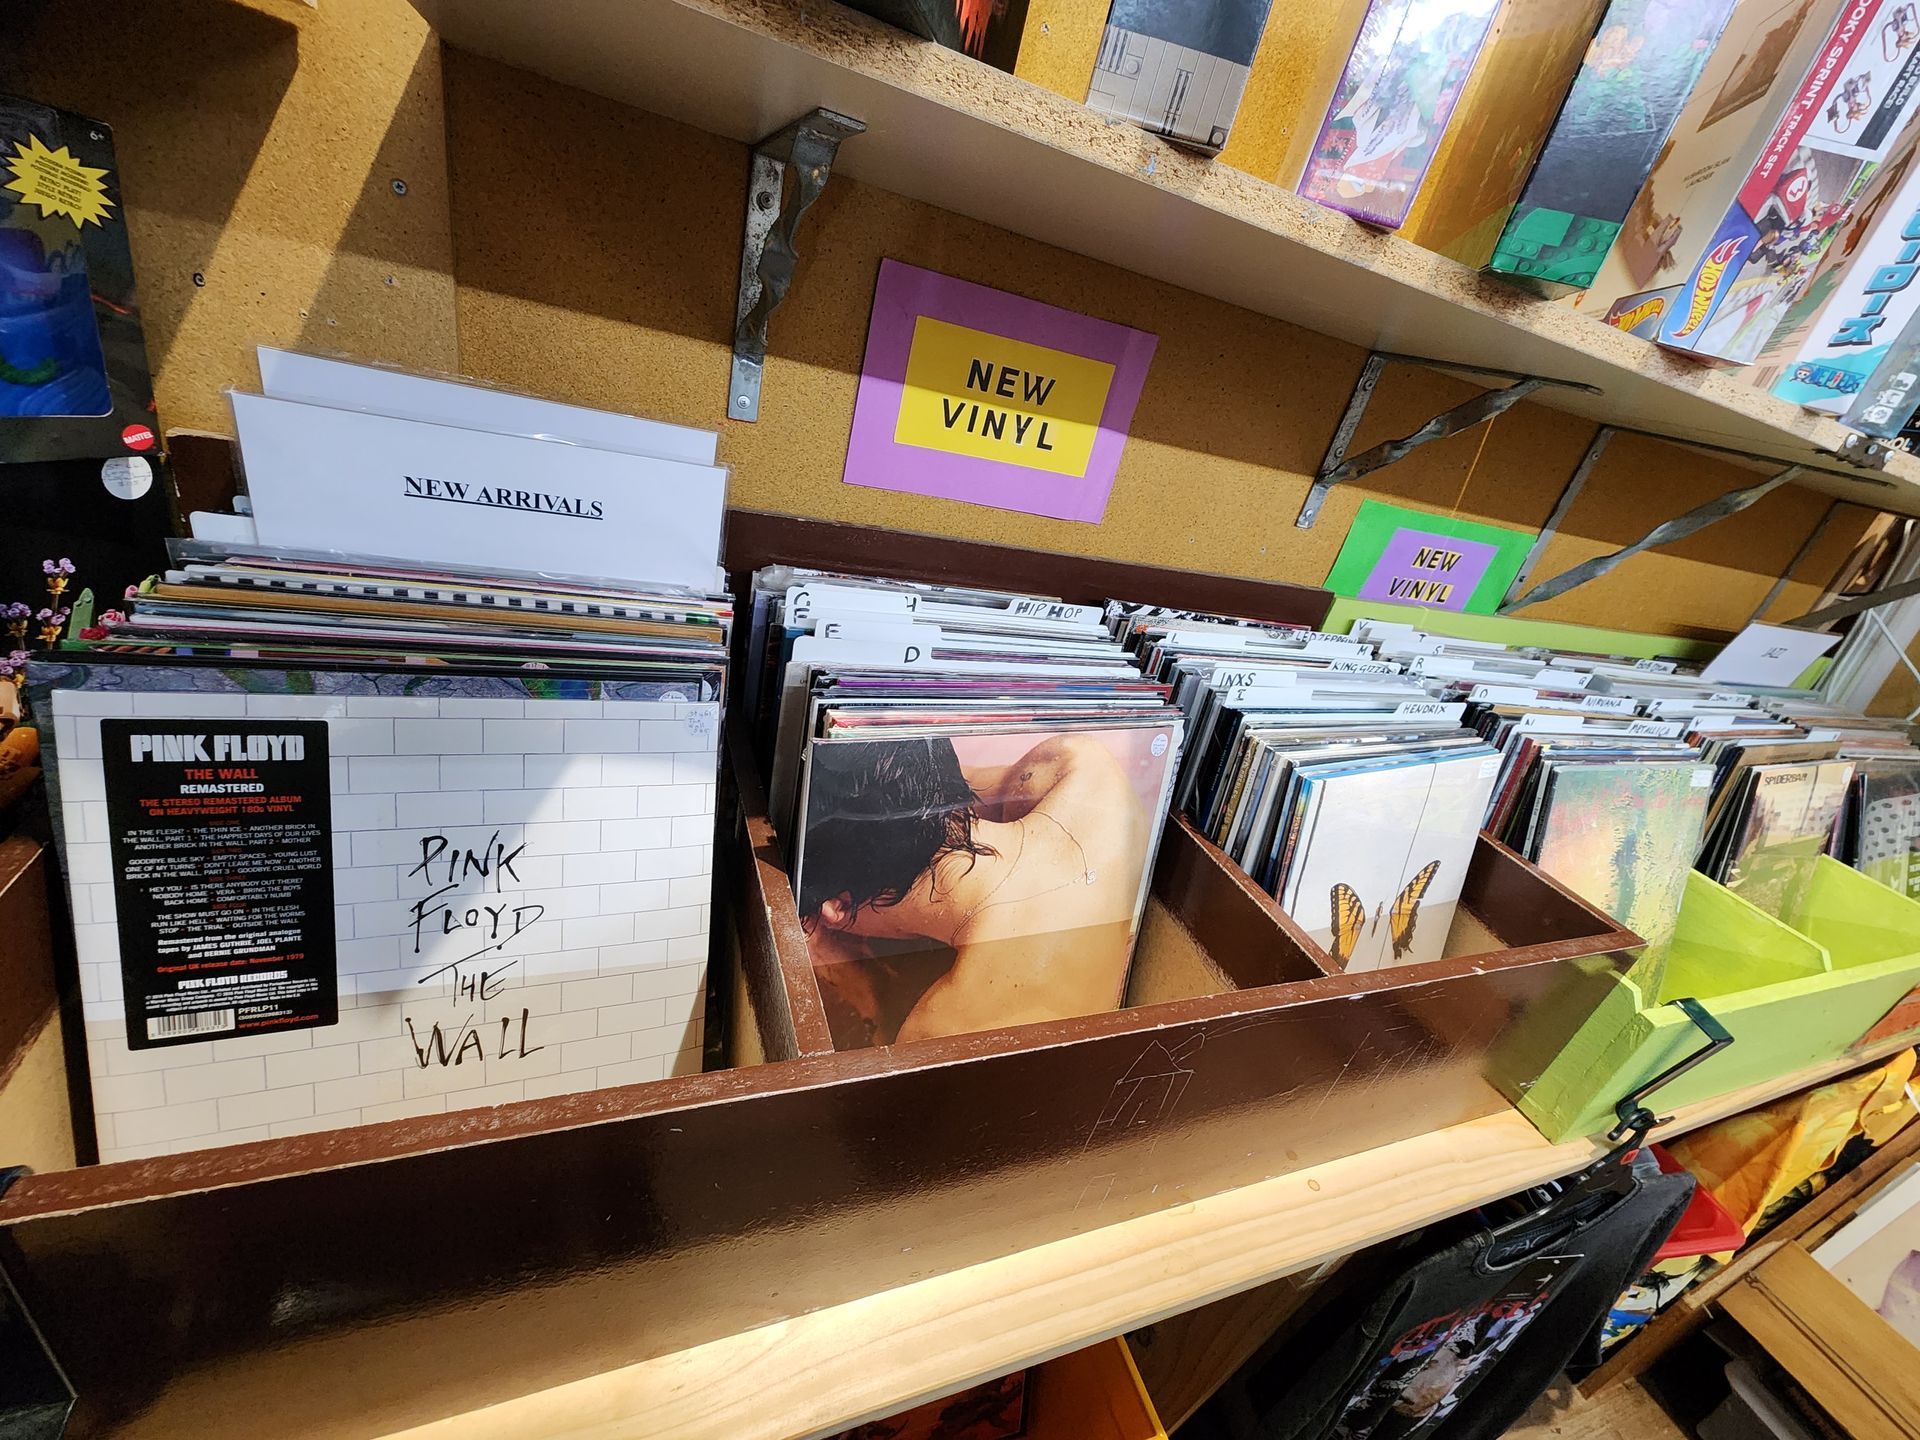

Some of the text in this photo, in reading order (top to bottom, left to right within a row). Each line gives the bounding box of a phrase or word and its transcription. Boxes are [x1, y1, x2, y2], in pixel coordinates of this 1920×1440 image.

[1802, 46, 1843, 110] SPRINT
[90, 131, 104, 141] 6+
[1774, 113, 1803, 153] TRACK
[1760, 155, 1778, 179] SET
[966, 359, 1056, 406] NEW
[943, 398, 1053, 451] VINYL
[123, 431, 153, 445] MATTEL
[403, 475, 604, 518] NEW ARRIVALS
[1412, 548, 1462, 572] NEW
[1389, 577, 1449, 603] VINYL
[1014, 602, 1083, 620] HIP HOP
[1359, 621, 1369, 631] V
[1295, 631, 1317, 643] LED
[1418, 633, 1427, 642] T
[904, 646, 921, 664] D
[1357, 645, 1369, 655] M
[1330, 661, 1358, 674] KING
[1416, 657, 1425, 668] R
[1219, 672, 1257, 687] INXS
[1402, 703, 1448, 715] HENDRIX
[1586, 698, 1623, 707] NIRVANA
[1628, 723, 1671, 737] METALLICA
[129, 734, 305, 763] PINK FLOYD
[184, 769, 259, 780] THE WALL
[180, 783, 265, 794] REMASTERED
[140, 795, 302, 807] THE STEREO REMASTERED ALBUM
[149, 808, 164, 816] ON
[167, 806, 239, 816] HEAVYWEIGHT
[267, 804, 295, 812] VINYL
[408, 829, 533, 893] PINK
[216, 894, 268, 902] COMFORTABLY
[408, 883, 545, 953] FLOYD
[158, 936, 204, 946] Remastered
[238, 931, 267, 940] original
[268, 929, 302, 937] analogue
[192, 942, 218, 950] JAMES
[275, 935, 302, 943] PLANTE
[204, 948, 232, 957] BERNIE
[234, 946, 276, 954] GRUNDMAN
[157, 964, 188, 973] Original
[418, 945, 519, 1007] THE
[178, 970, 288, 990] PINK FLOYD RECORDS
[238, 1004, 279, 1014] PFRLP11
[238, 1014, 319, 1029] www.pinkfloyd.com
[405, 1008, 545, 1069] WALL
